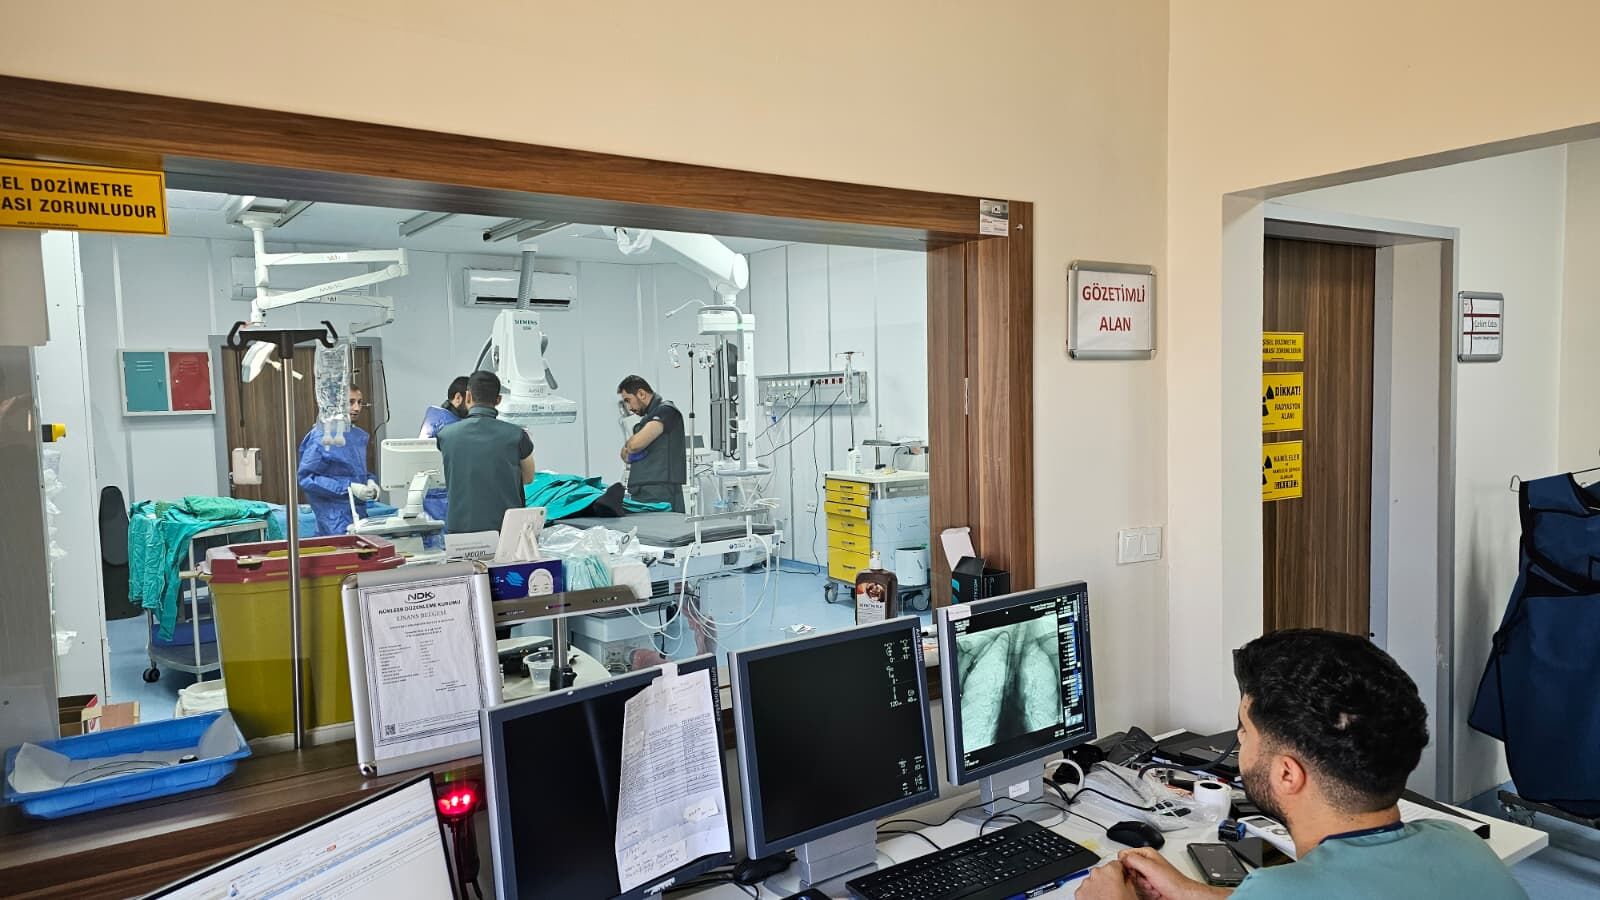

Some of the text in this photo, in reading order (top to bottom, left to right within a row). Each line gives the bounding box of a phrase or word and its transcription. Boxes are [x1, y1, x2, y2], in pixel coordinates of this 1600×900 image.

[0, 176, 134, 198] EL DOZİMETRE
[1, 197, 157, 218] ASI ZORUNLUDUR
[1082, 282, 1145, 303] GÖZETİMLİ
[1099, 316, 1131, 332] ALAN
[1275, 384, 1301, 397] DİKKAT!
[407, 591, 433, 601] NDK
